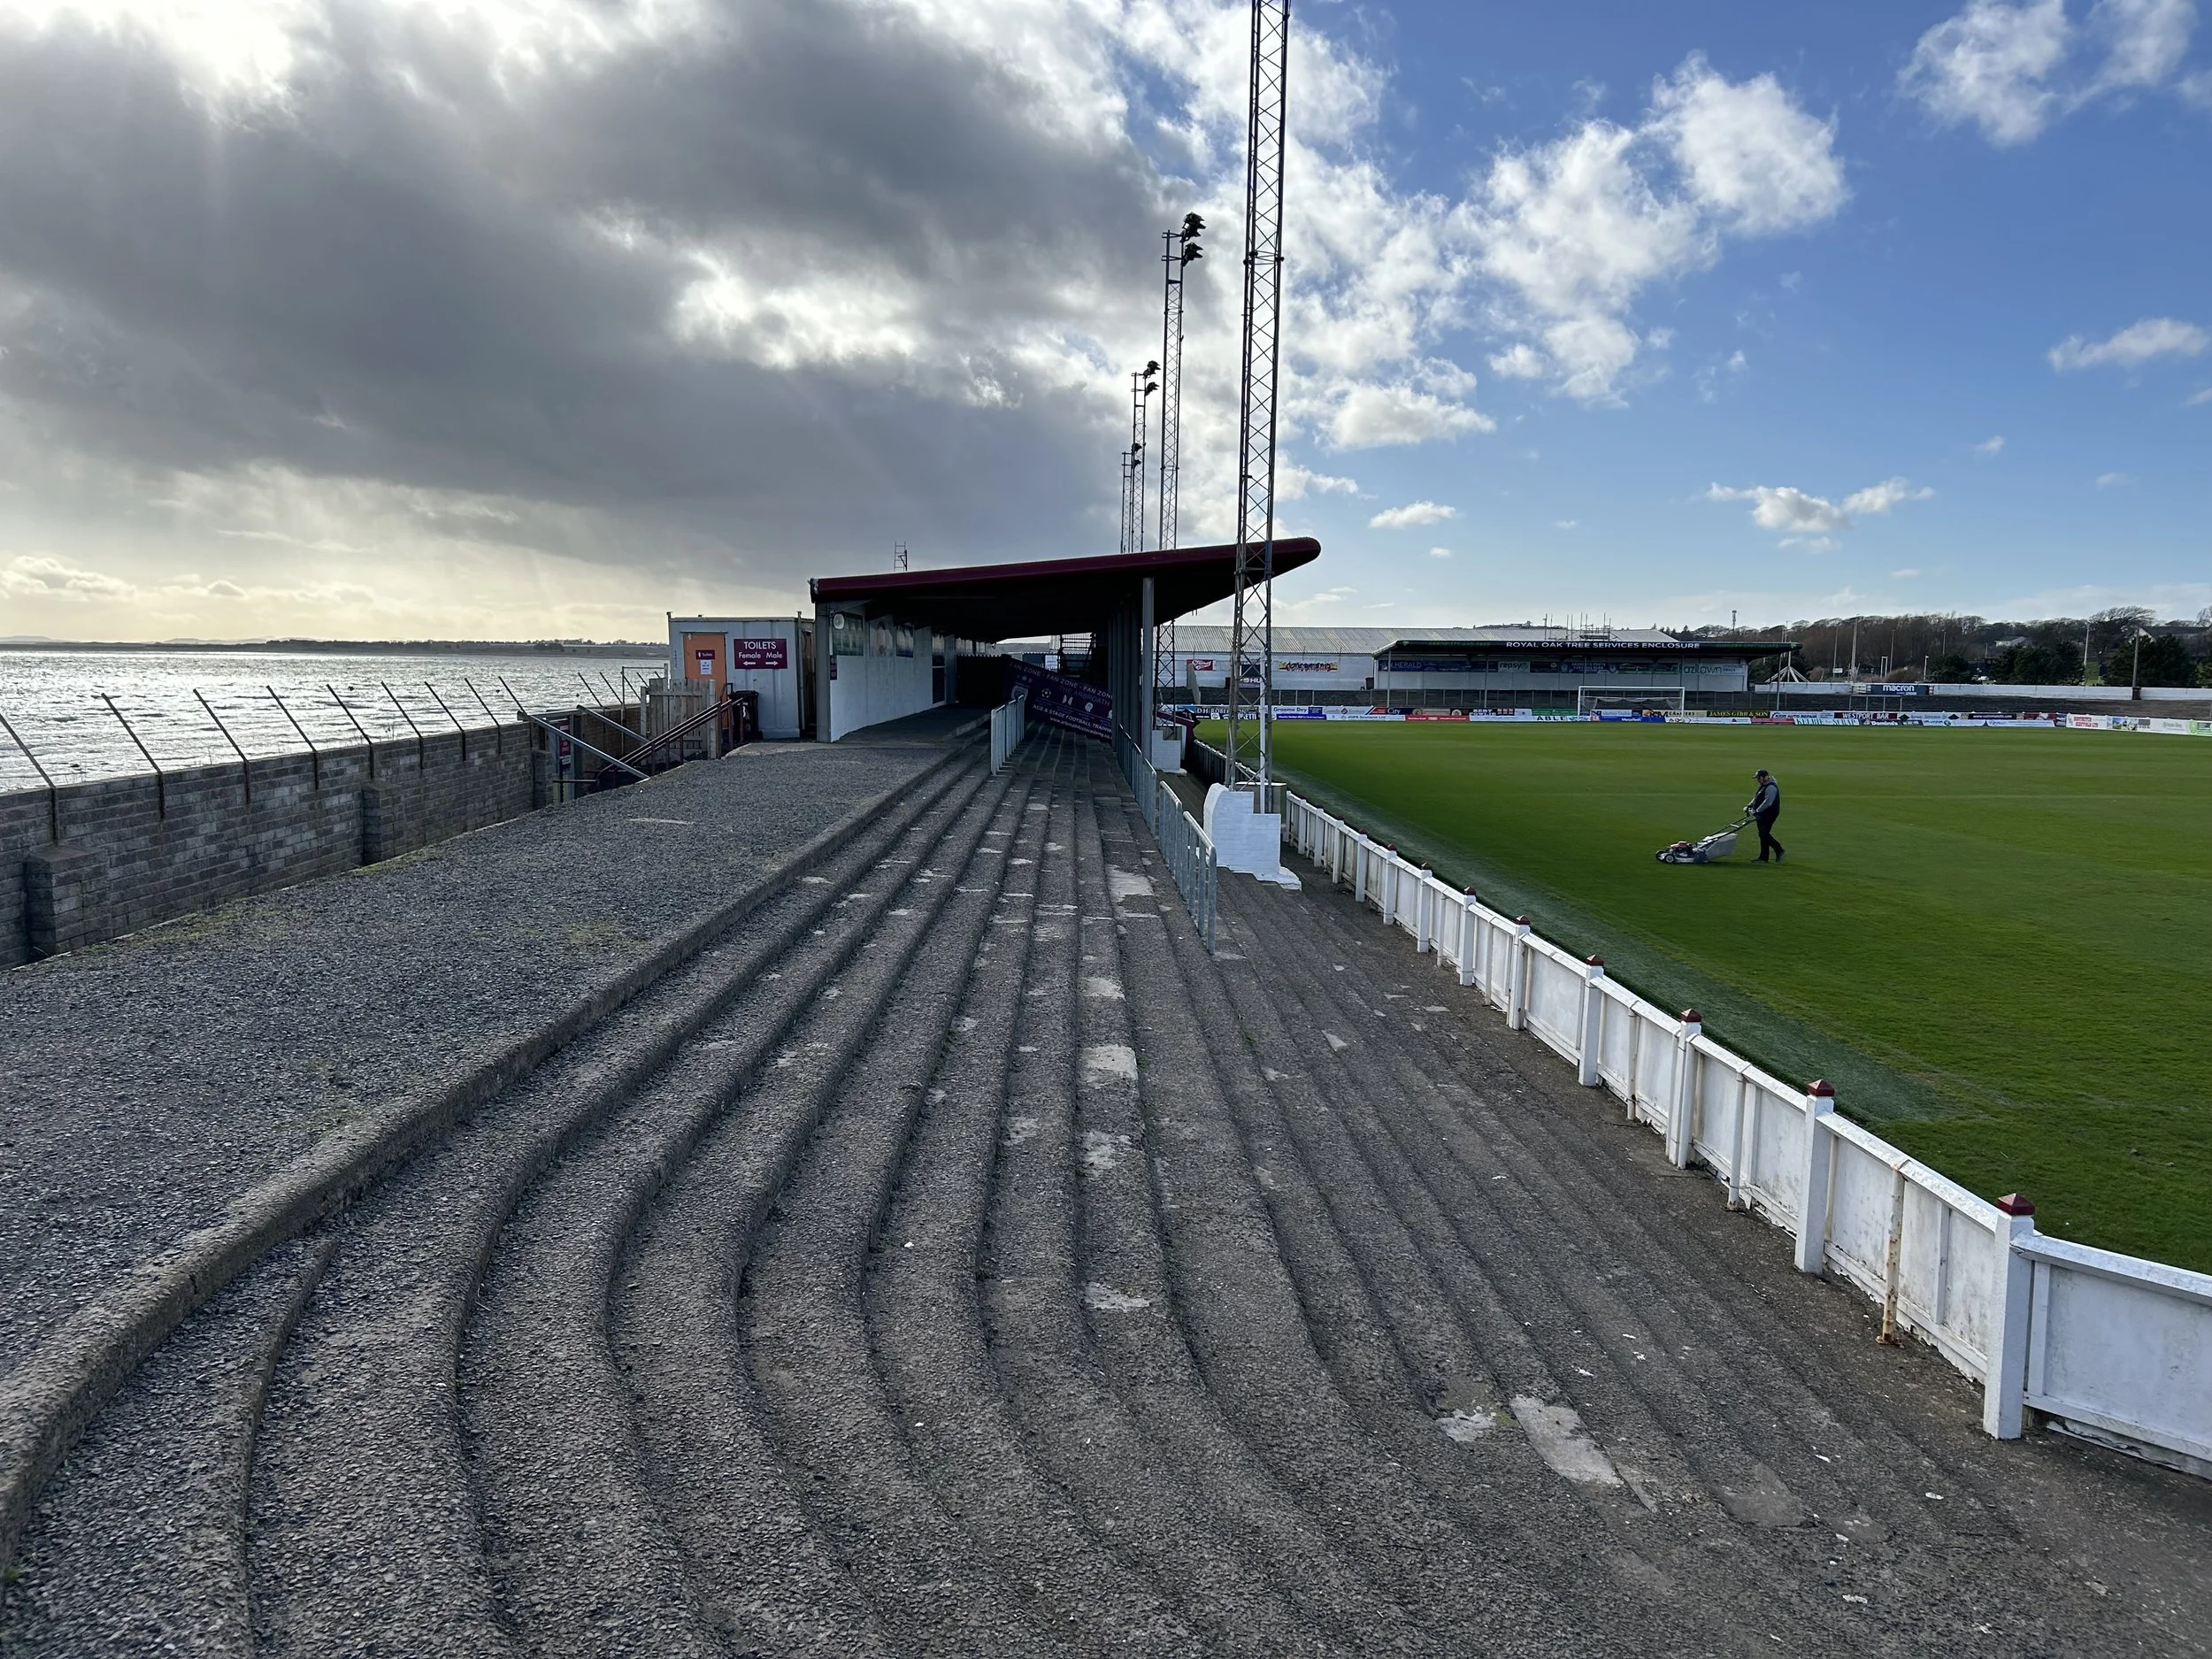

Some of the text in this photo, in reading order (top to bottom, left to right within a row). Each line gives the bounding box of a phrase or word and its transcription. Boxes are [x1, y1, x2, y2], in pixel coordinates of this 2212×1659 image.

[743, 641, 777, 649] TOILETS
[1023, 666, 1041, 677] ZONE
[1061, 679, 1079, 688] ZONE
[1083, 686, 1095, 695] FAN
[1073, 690, 1111, 707] ARBROATH
[1065, 715, 1092, 727] FOOTBALL
